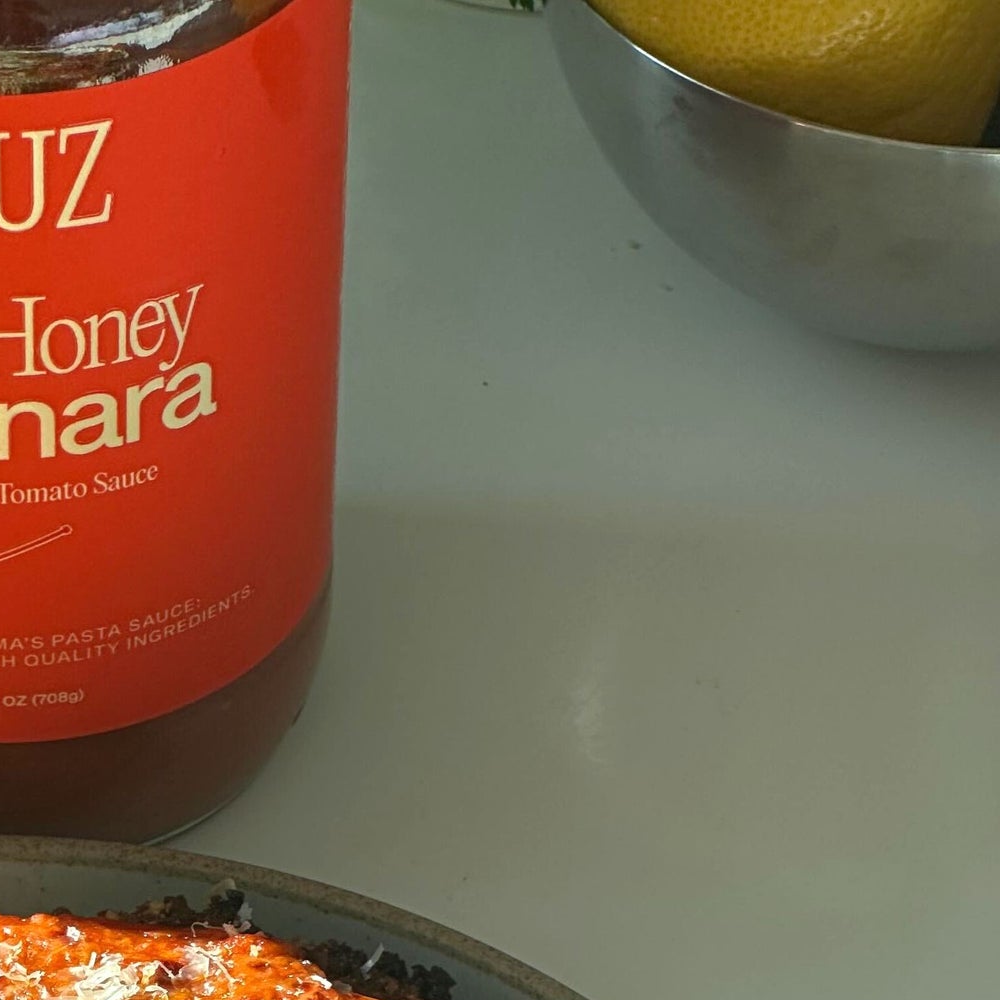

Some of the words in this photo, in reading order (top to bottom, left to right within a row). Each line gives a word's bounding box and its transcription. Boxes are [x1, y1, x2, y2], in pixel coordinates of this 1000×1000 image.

[93, 464, 159, 495] Sauce
[52, 624, 121, 647] PASTA
[24, 643, 119, 667] QUALITY
[2, 695, 27, 707] OZ
[32, 688, 84, 707] (708g)
